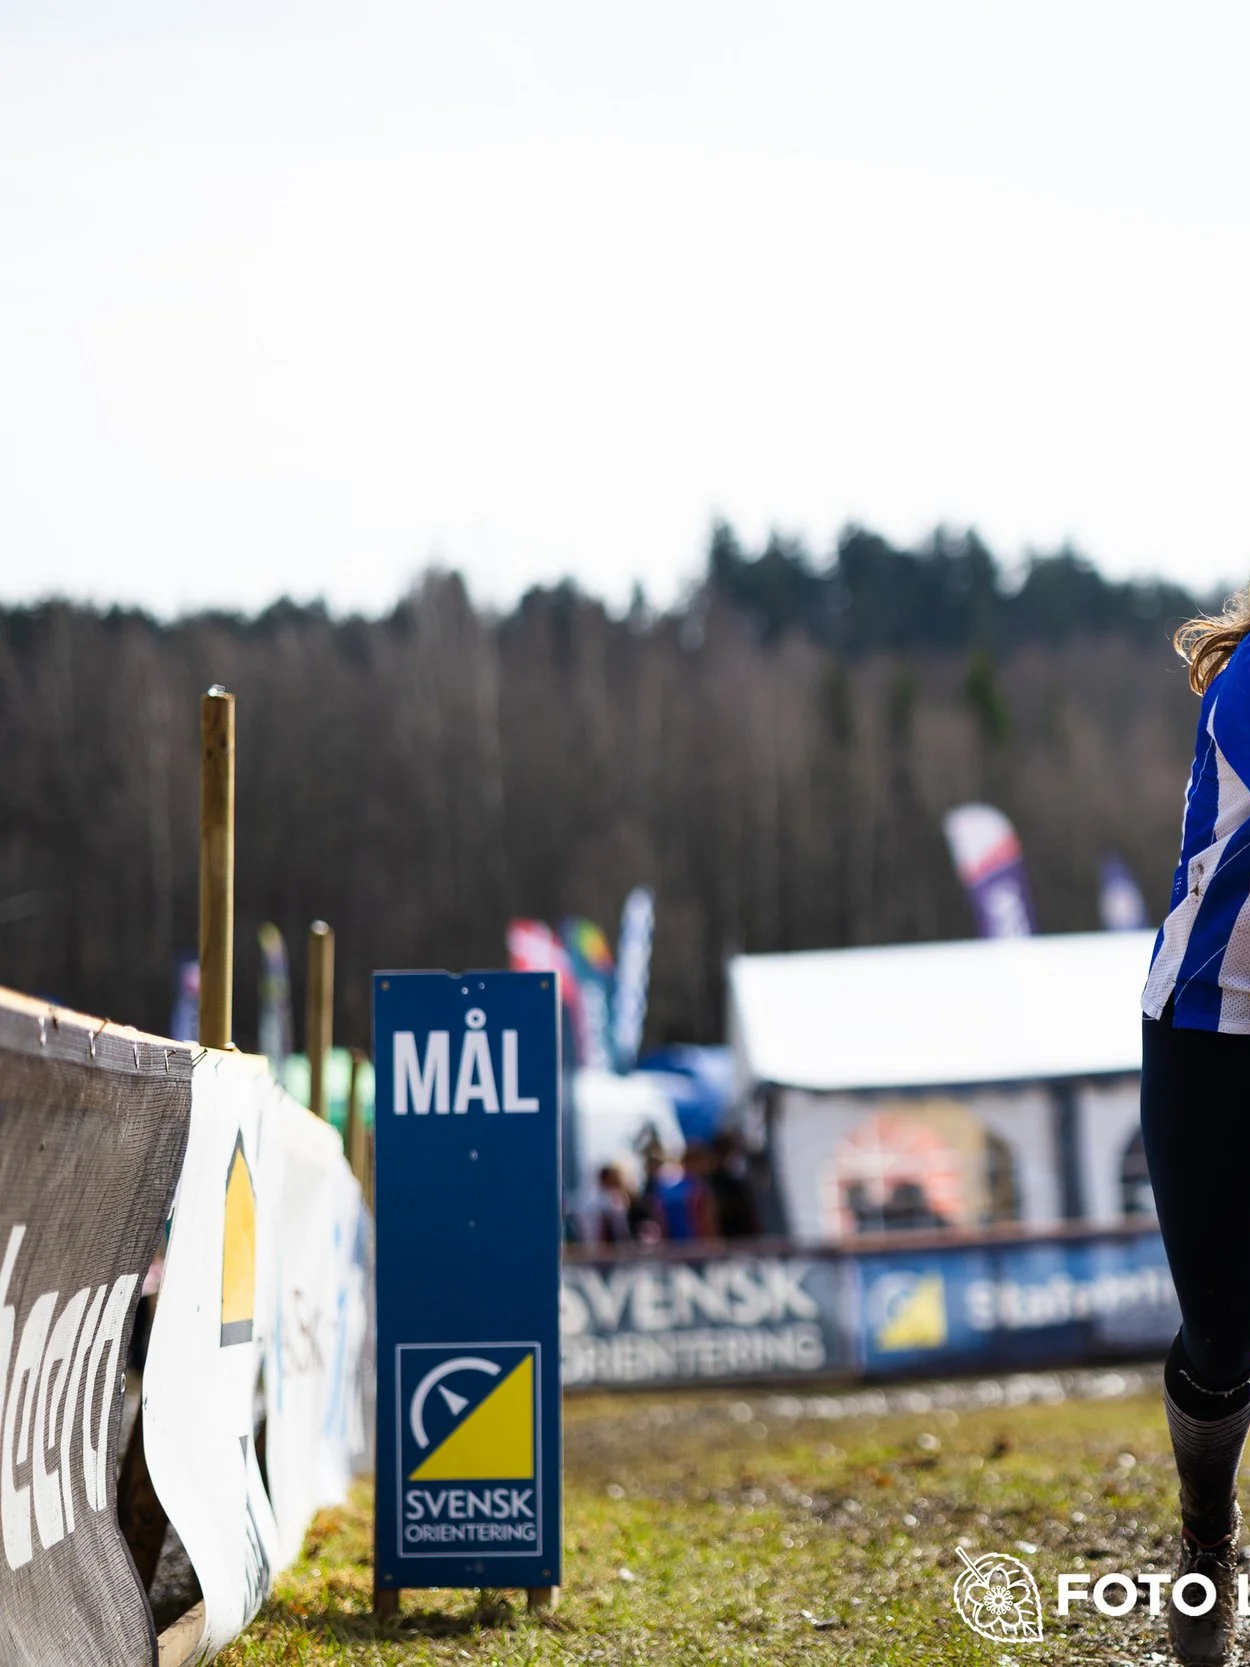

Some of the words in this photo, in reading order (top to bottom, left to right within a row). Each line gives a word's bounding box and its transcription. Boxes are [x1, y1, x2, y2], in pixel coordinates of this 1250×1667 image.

[393, 1008, 539, 1115] MÅL
[560, 1257, 818, 1334] SVENSK
[560, 1322, 827, 1384] ORIENTERING
[404, 1523, 537, 1543] ORIENTERING
[405, 1488, 535, 1520] SVENSK
